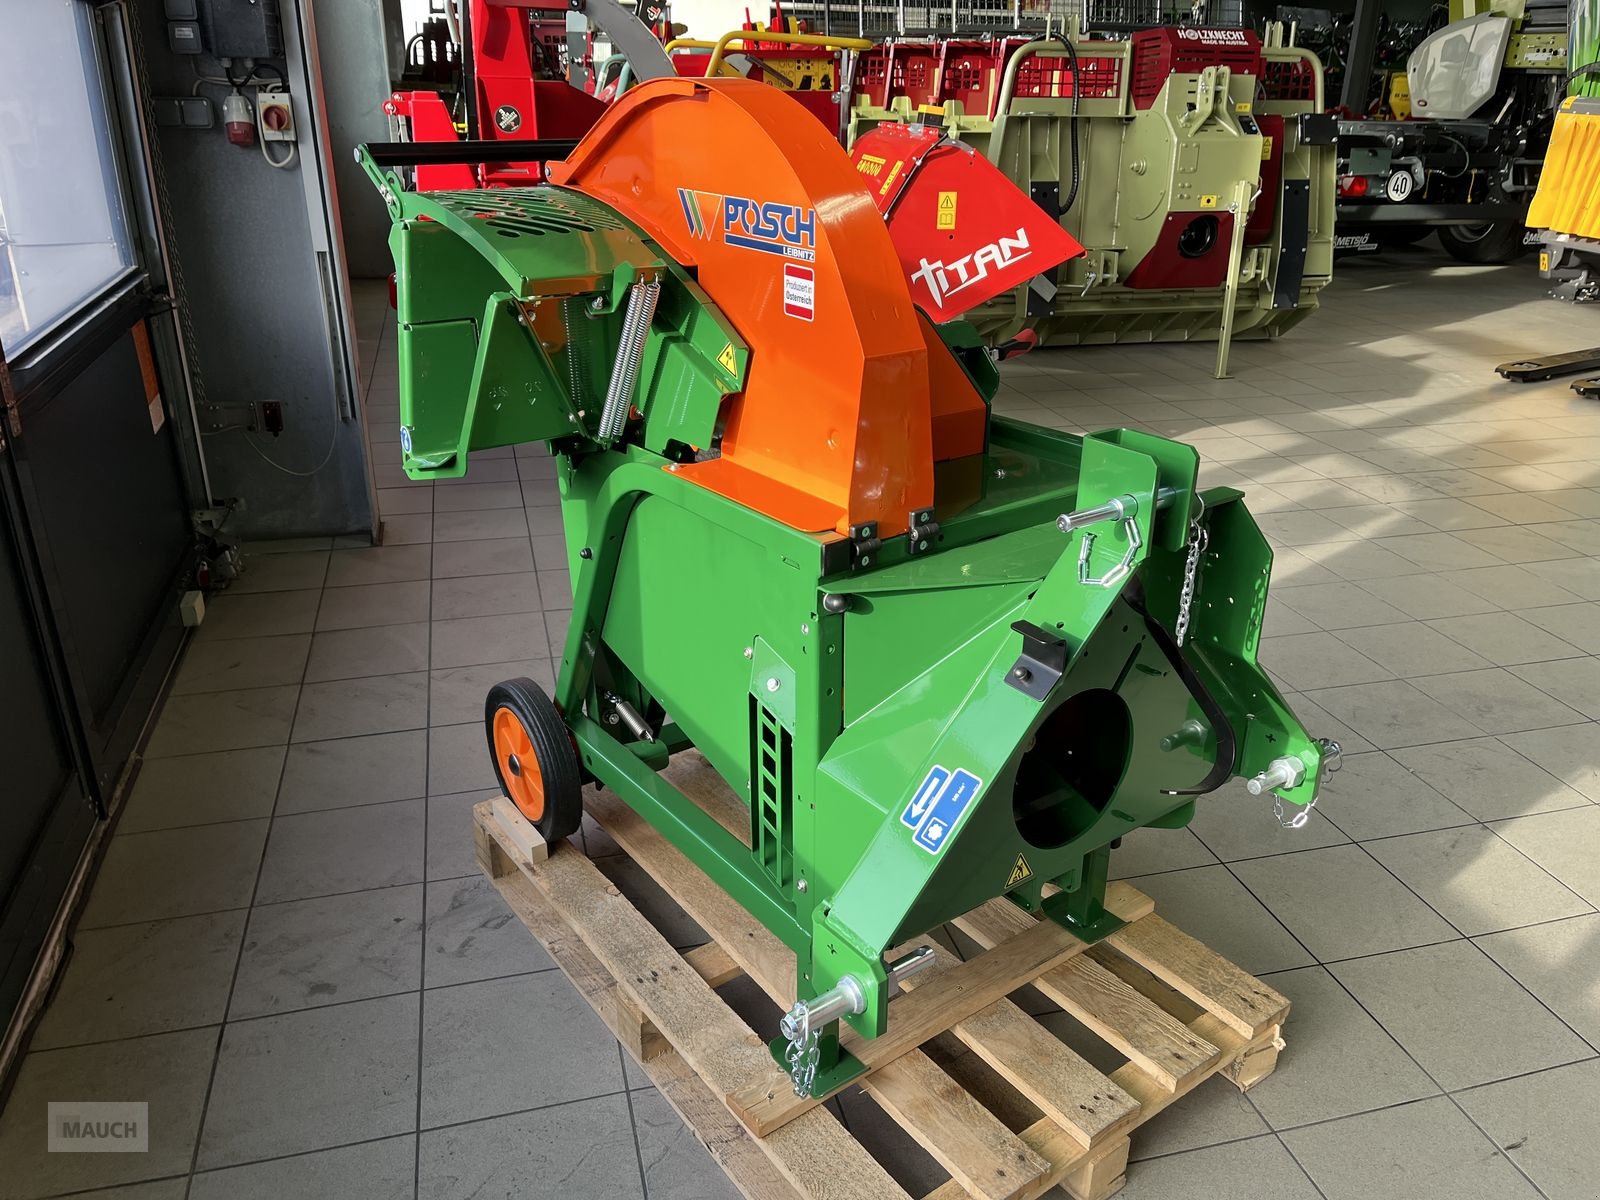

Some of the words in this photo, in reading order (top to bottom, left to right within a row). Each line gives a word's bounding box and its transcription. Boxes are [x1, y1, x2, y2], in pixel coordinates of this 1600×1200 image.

[1177, 28, 1246, 41] HOLZKNECHT
[1392, 176, 1408, 194] 40
[724, 194, 816, 249] POSCH
[782, 245, 815, 262] LEIBNITZ
[910, 227, 1033, 309] TITAN
[785, 278, 807, 293] Produziert
